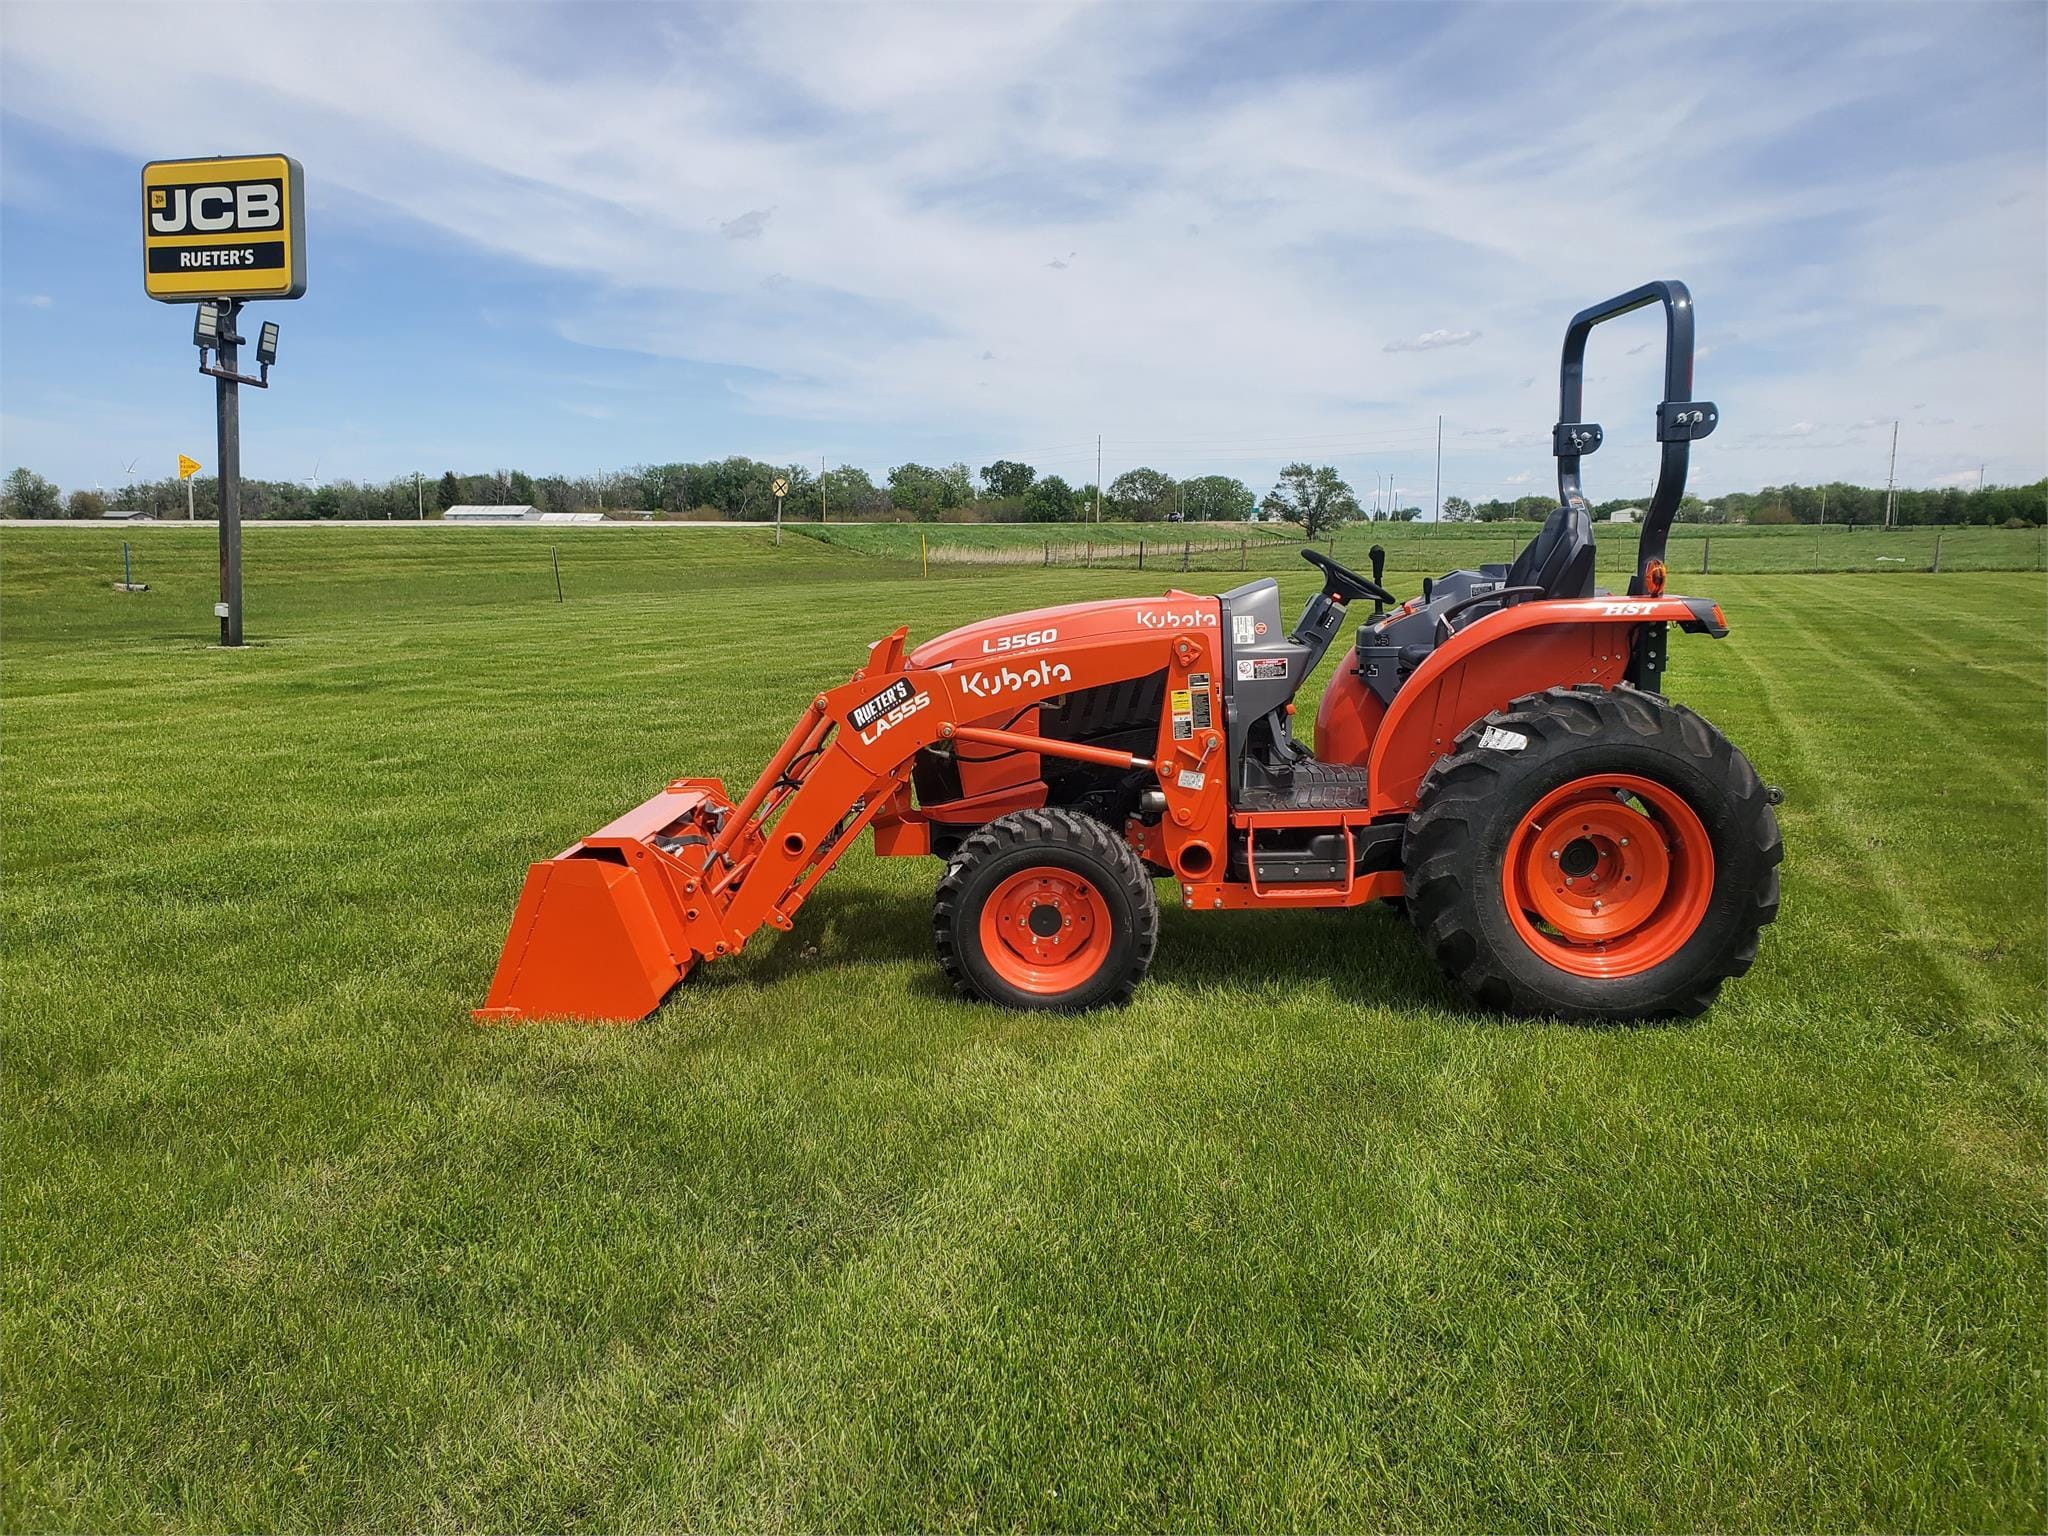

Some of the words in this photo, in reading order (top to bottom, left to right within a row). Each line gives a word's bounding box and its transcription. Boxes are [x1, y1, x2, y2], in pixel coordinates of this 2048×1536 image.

[152, 184, 280, 232] JCB
[180, 249, 254, 267] RUETER'S
[1137, 610, 1217, 628] Kubota
[1602, 603, 1658, 616] HST
[982, 629, 1057, 653] L3560
[960, 660, 1072, 697] Kubota
[853, 681, 908, 727] RUETER'S
[860, 690, 931, 746] LA555
